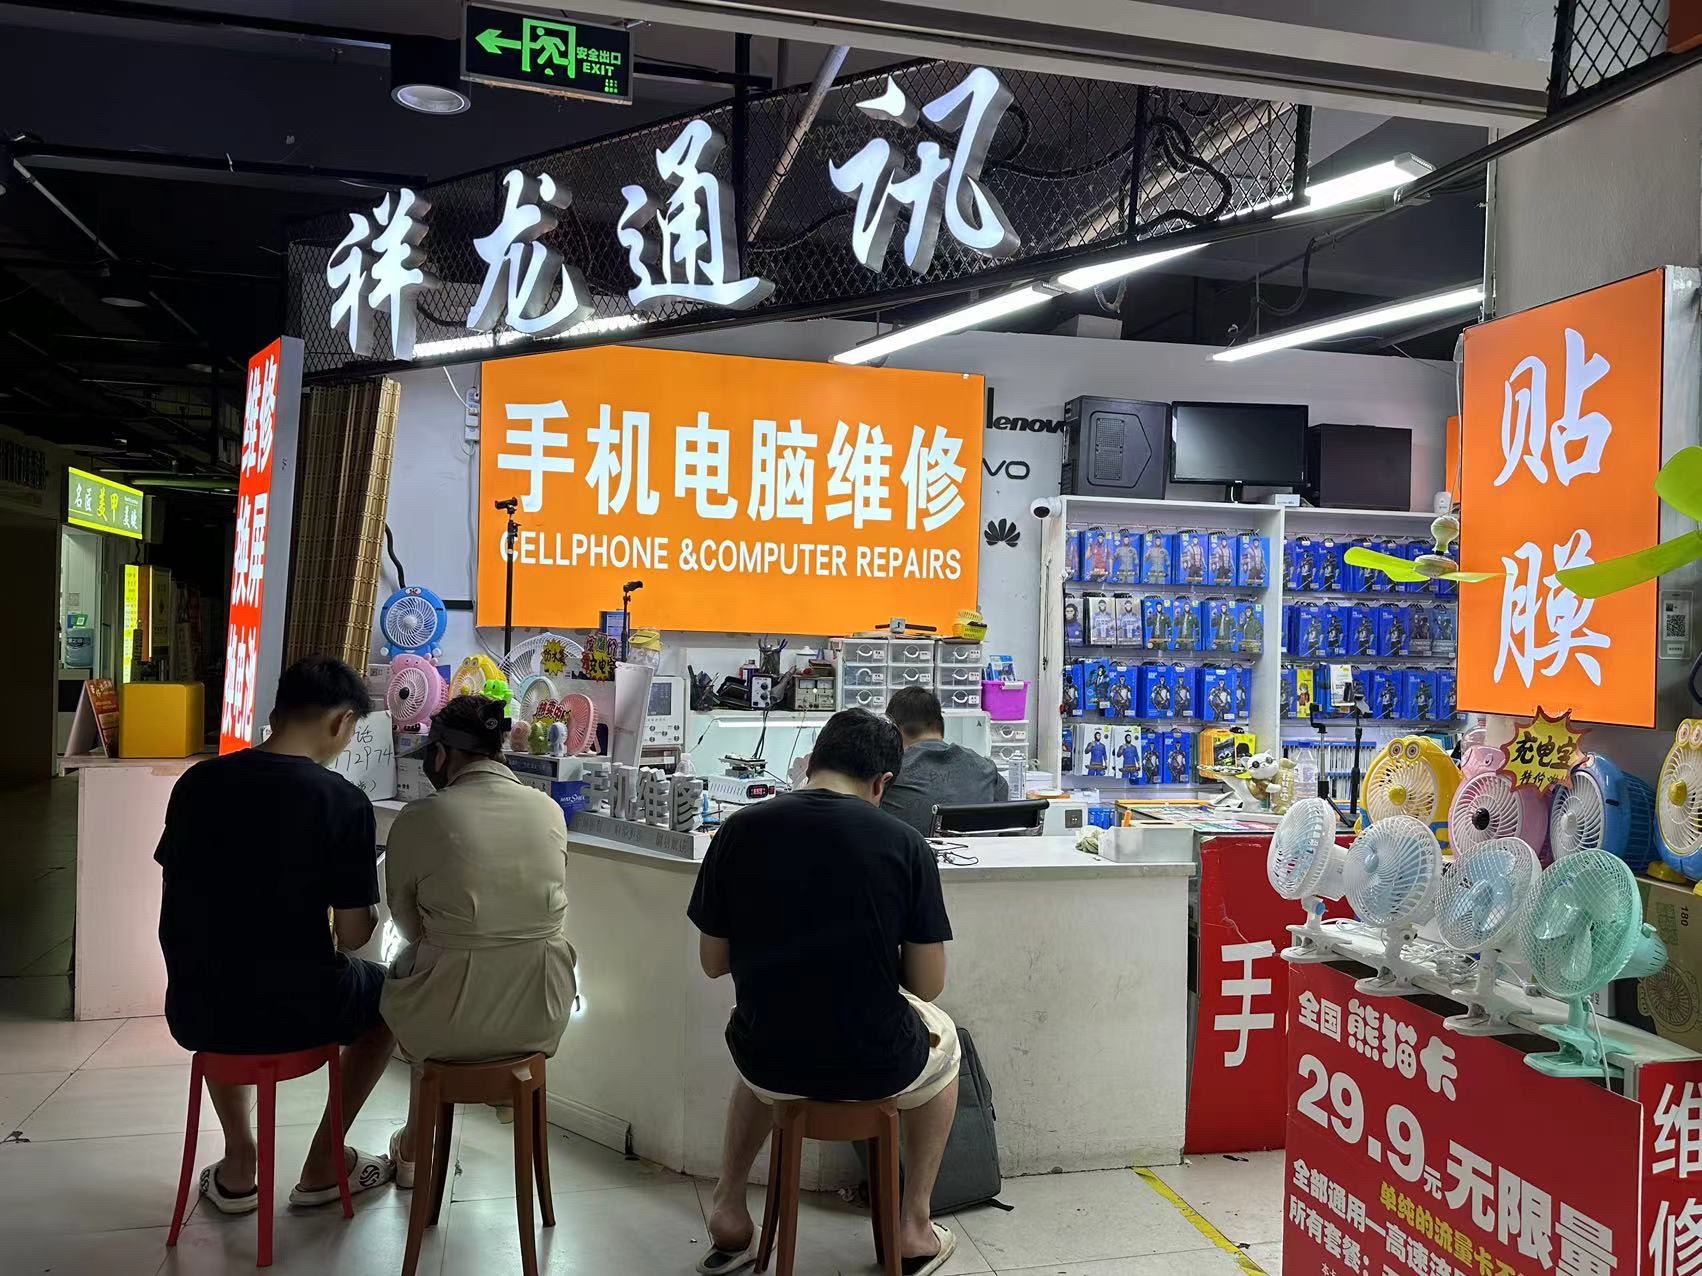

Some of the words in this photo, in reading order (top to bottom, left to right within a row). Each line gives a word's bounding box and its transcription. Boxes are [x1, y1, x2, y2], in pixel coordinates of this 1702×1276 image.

[577, 47, 622, 65] 安全出口
[583, 62, 615, 77] EXIT
[328, 66, 1016, 362] 祥龙通讯
[241, 354, 278, 478] 维修
[985, 386, 1066, 434] lenov
[497, 400, 968, 533] 手机电脑维修
[1493, 327, 1613, 689] 贴膜
[231, 492, 268, 608] 换屏
[499, 531, 669, 571] CELLPHONE
[679, 538, 848, 578] &COMPUTER
[855, 545, 962, 580] REPAIRS
[221, 623, 257, 743] 换电池
[1511, 730, 1578, 770] 充电宝
[1680, 905, 1690, 928] 180
[1213, 939, 1276, 1068] 手
[1380, 1180, 1524, 1276] 单纯的流量卡
